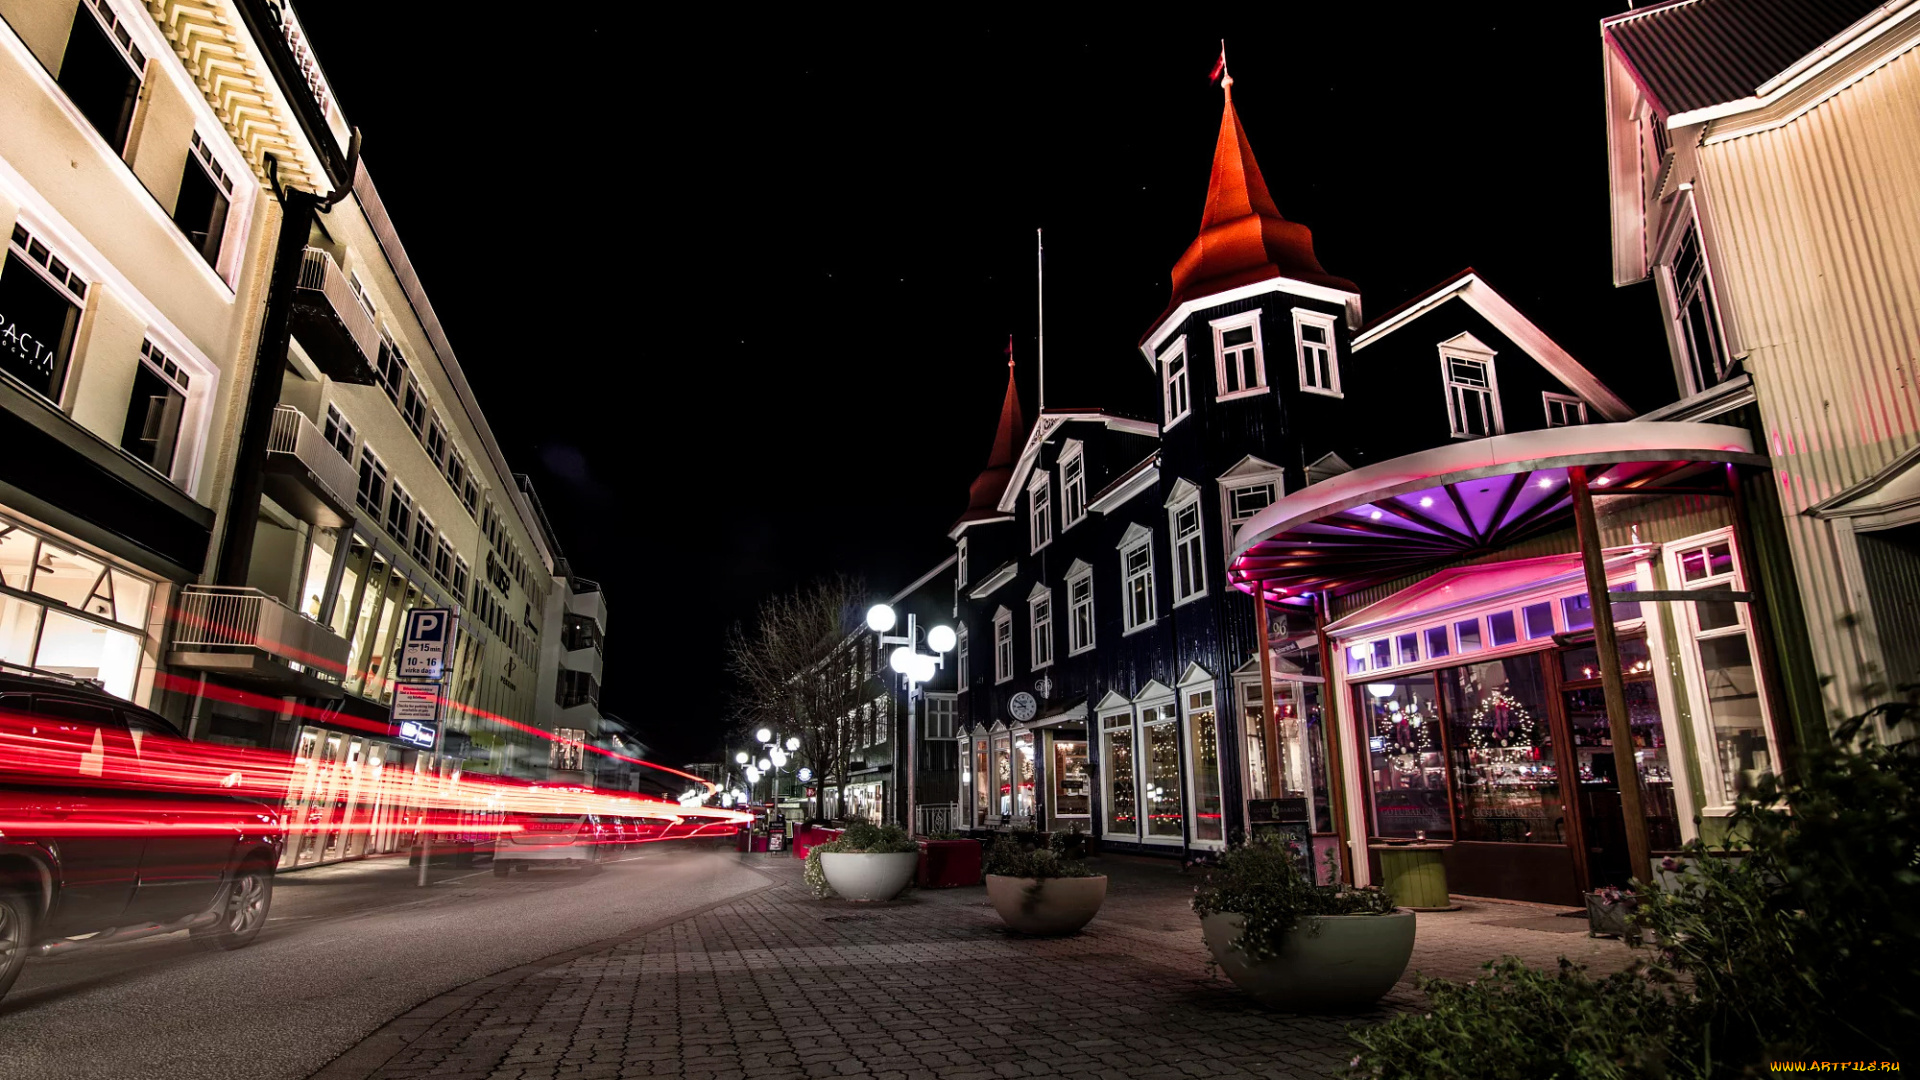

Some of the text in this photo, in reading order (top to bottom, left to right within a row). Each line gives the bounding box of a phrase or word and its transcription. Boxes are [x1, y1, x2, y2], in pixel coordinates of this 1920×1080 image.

[415, 614, 438, 640] P
[420, 643, 430, 652] 15
[407, 657, 418, 666] 10
[426, 657, 437, 666] 16
